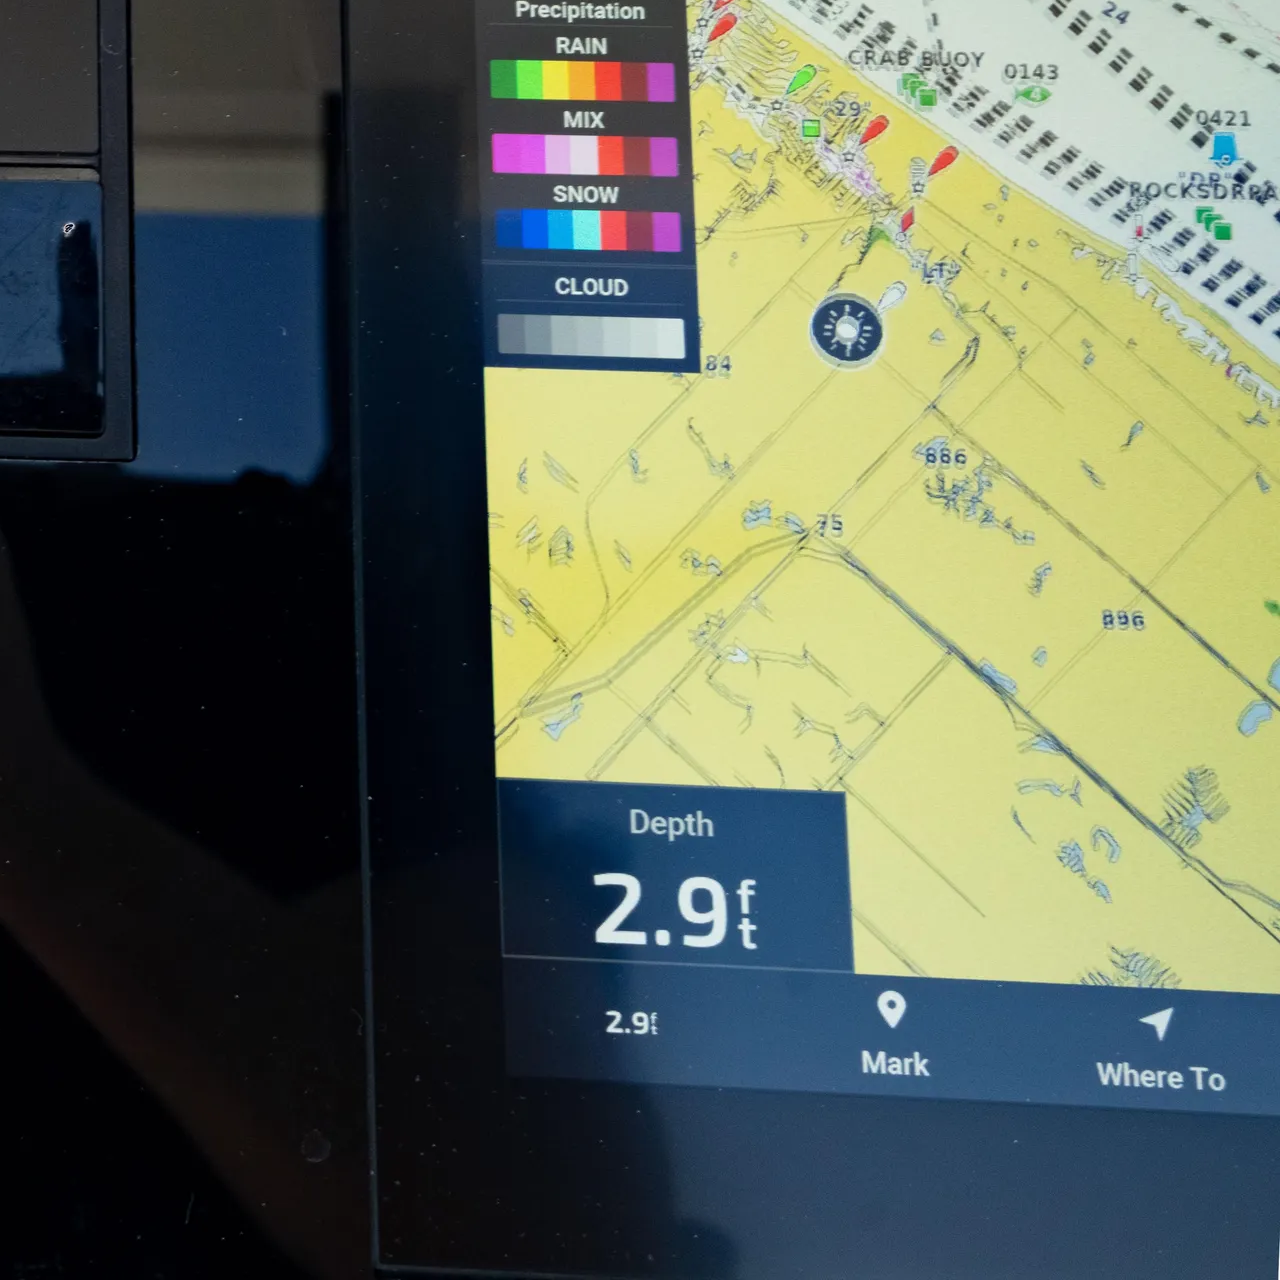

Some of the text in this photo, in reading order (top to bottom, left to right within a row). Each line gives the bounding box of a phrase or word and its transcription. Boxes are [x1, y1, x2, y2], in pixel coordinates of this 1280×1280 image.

[515, 0, 646, 21] Precipitation
[1102, 1, 1131, 24] 24
[556, 37, 608, 55] RAIN
[848, 49, 985, 68] CRAB BUOY
[1004, 64, 1059, 80] 0143
[563, 111, 605, 129] MIX
[1196, 110, 1251, 127] 0421
[553, 185, 620, 203] SNOW
[554, 277, 629, 296] CLOUD
[629, 808, 715, 840] Depth
[592, 872, 729, 949] 2.9
[861, 1050, 930, 1079] Mark
[1097, 1061, 1227, 1093] Where To
